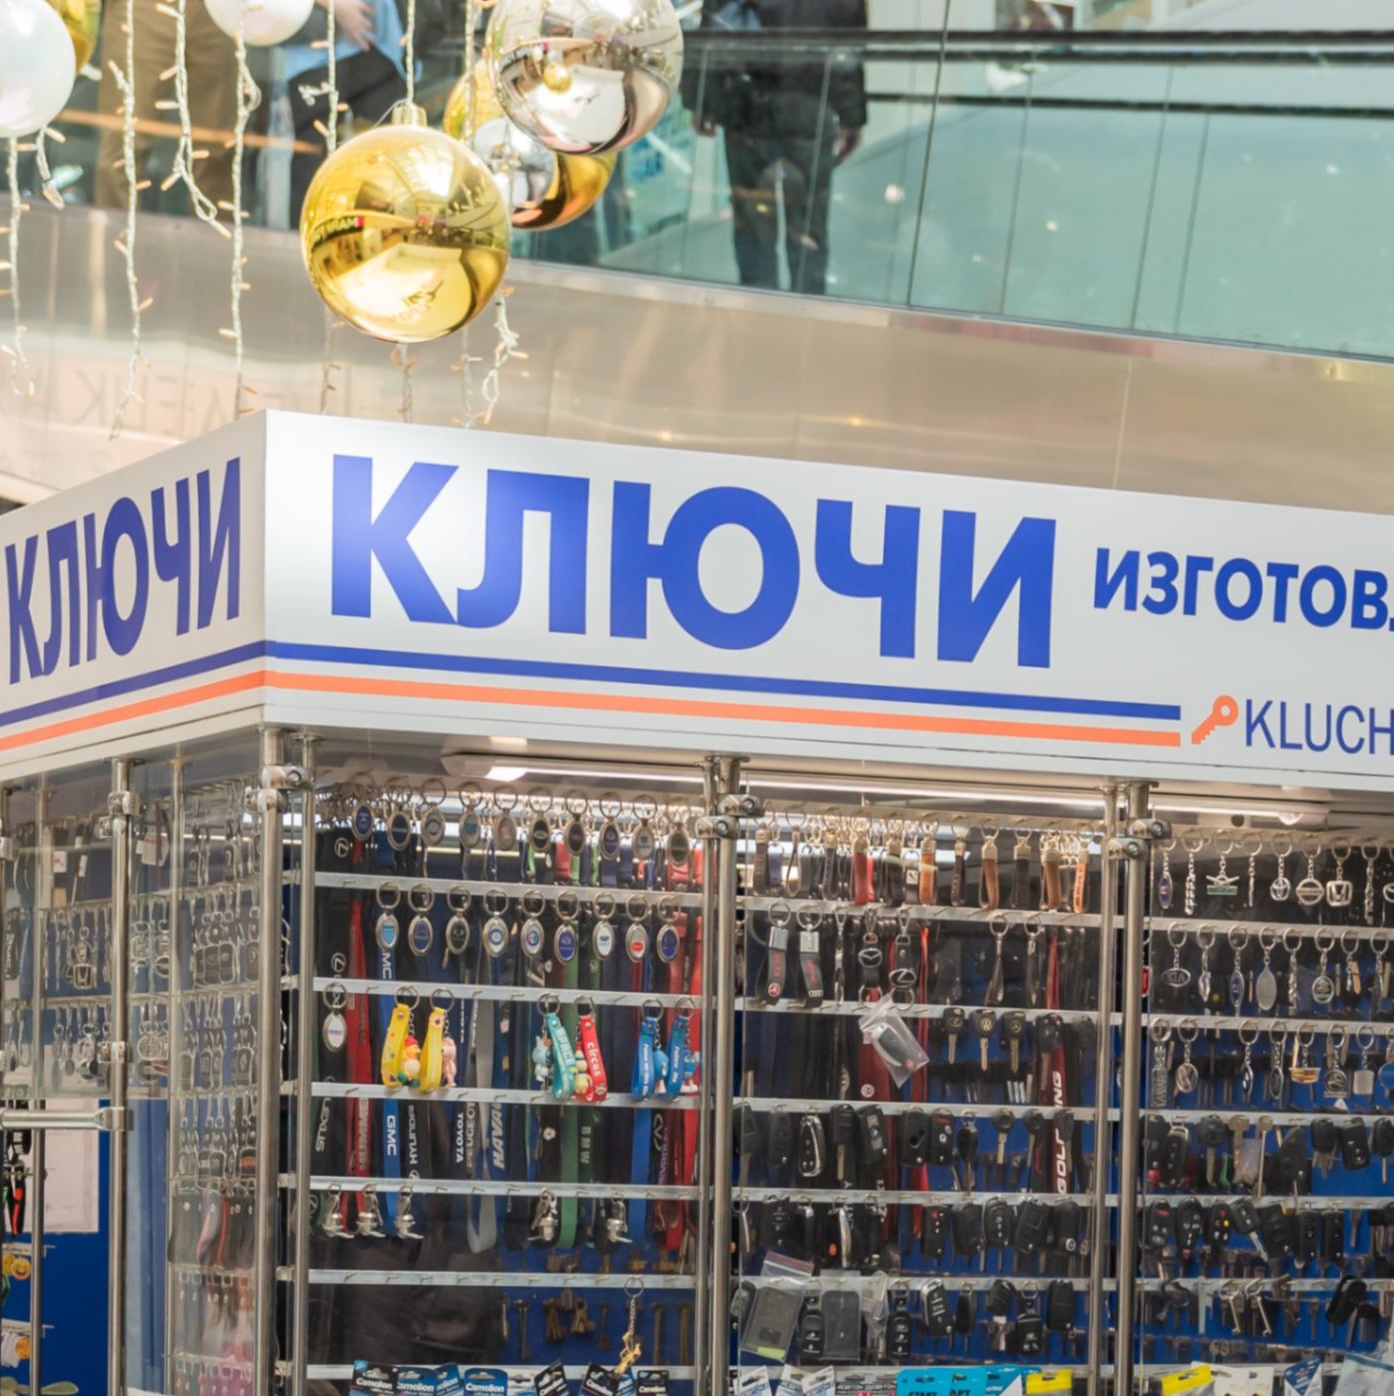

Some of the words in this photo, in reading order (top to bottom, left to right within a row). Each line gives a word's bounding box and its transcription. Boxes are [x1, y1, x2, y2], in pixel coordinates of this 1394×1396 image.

[5, 456, 242, 686] КЛЮЧИ
[330, 453, 1058, 670] КЛЮЧИ
[315, 1098, 333, 1152] LEXUS
[386, 1115, 397, 1156] GMC
[456, 1113, 464, 1163] TOYOTA
[356, 1377, 392, 1390] Camelion
[465, 1383, 505, 1394] Camelion
